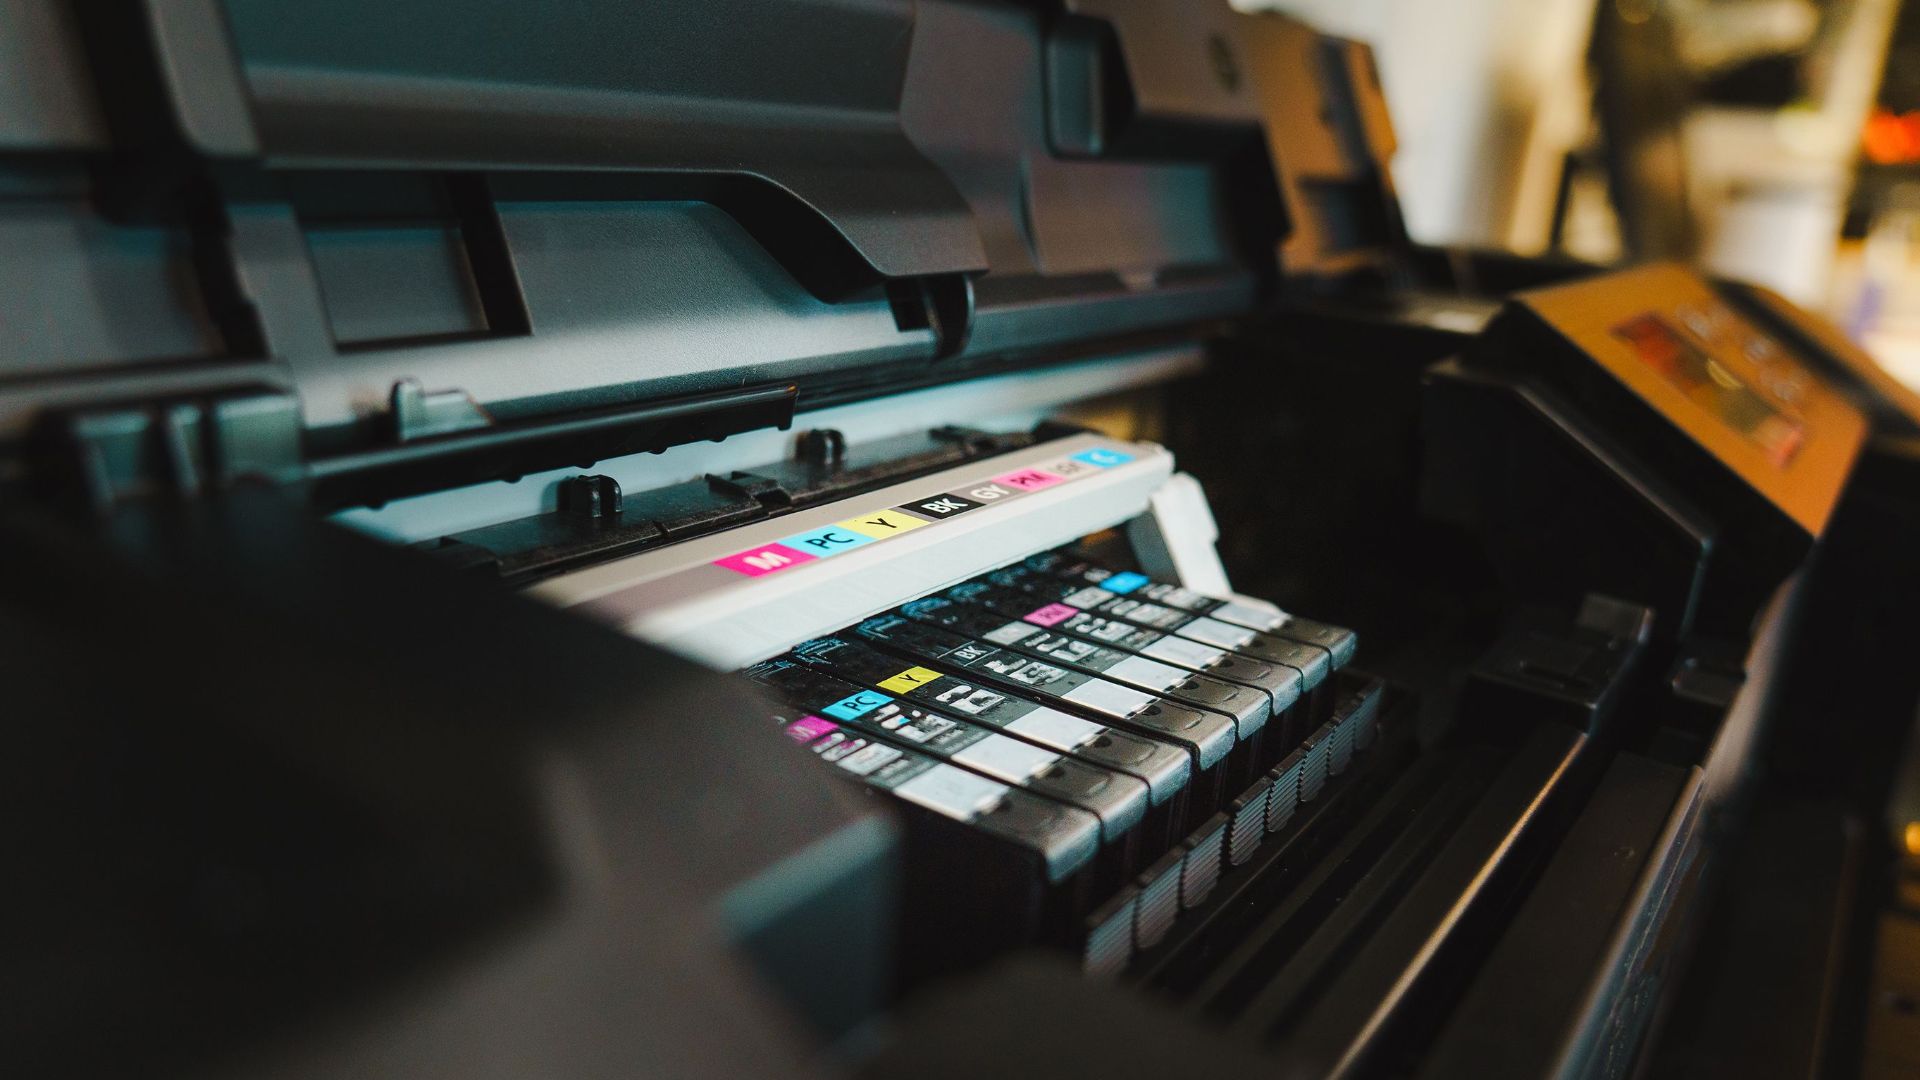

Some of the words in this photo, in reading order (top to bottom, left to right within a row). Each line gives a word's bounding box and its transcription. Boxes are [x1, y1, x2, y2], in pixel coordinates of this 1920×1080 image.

[744, 550, 793, 571] M
[804, 532, 855, 550] PC
[866, 517, 897, 529] Y
[921, 497, 969, 514] BK
[970, 483, 1010, 500] GY
[954, 645, 988, 661] BK
[898, 674, 921, 684] Y
[841, 696, 877, 712] PC
